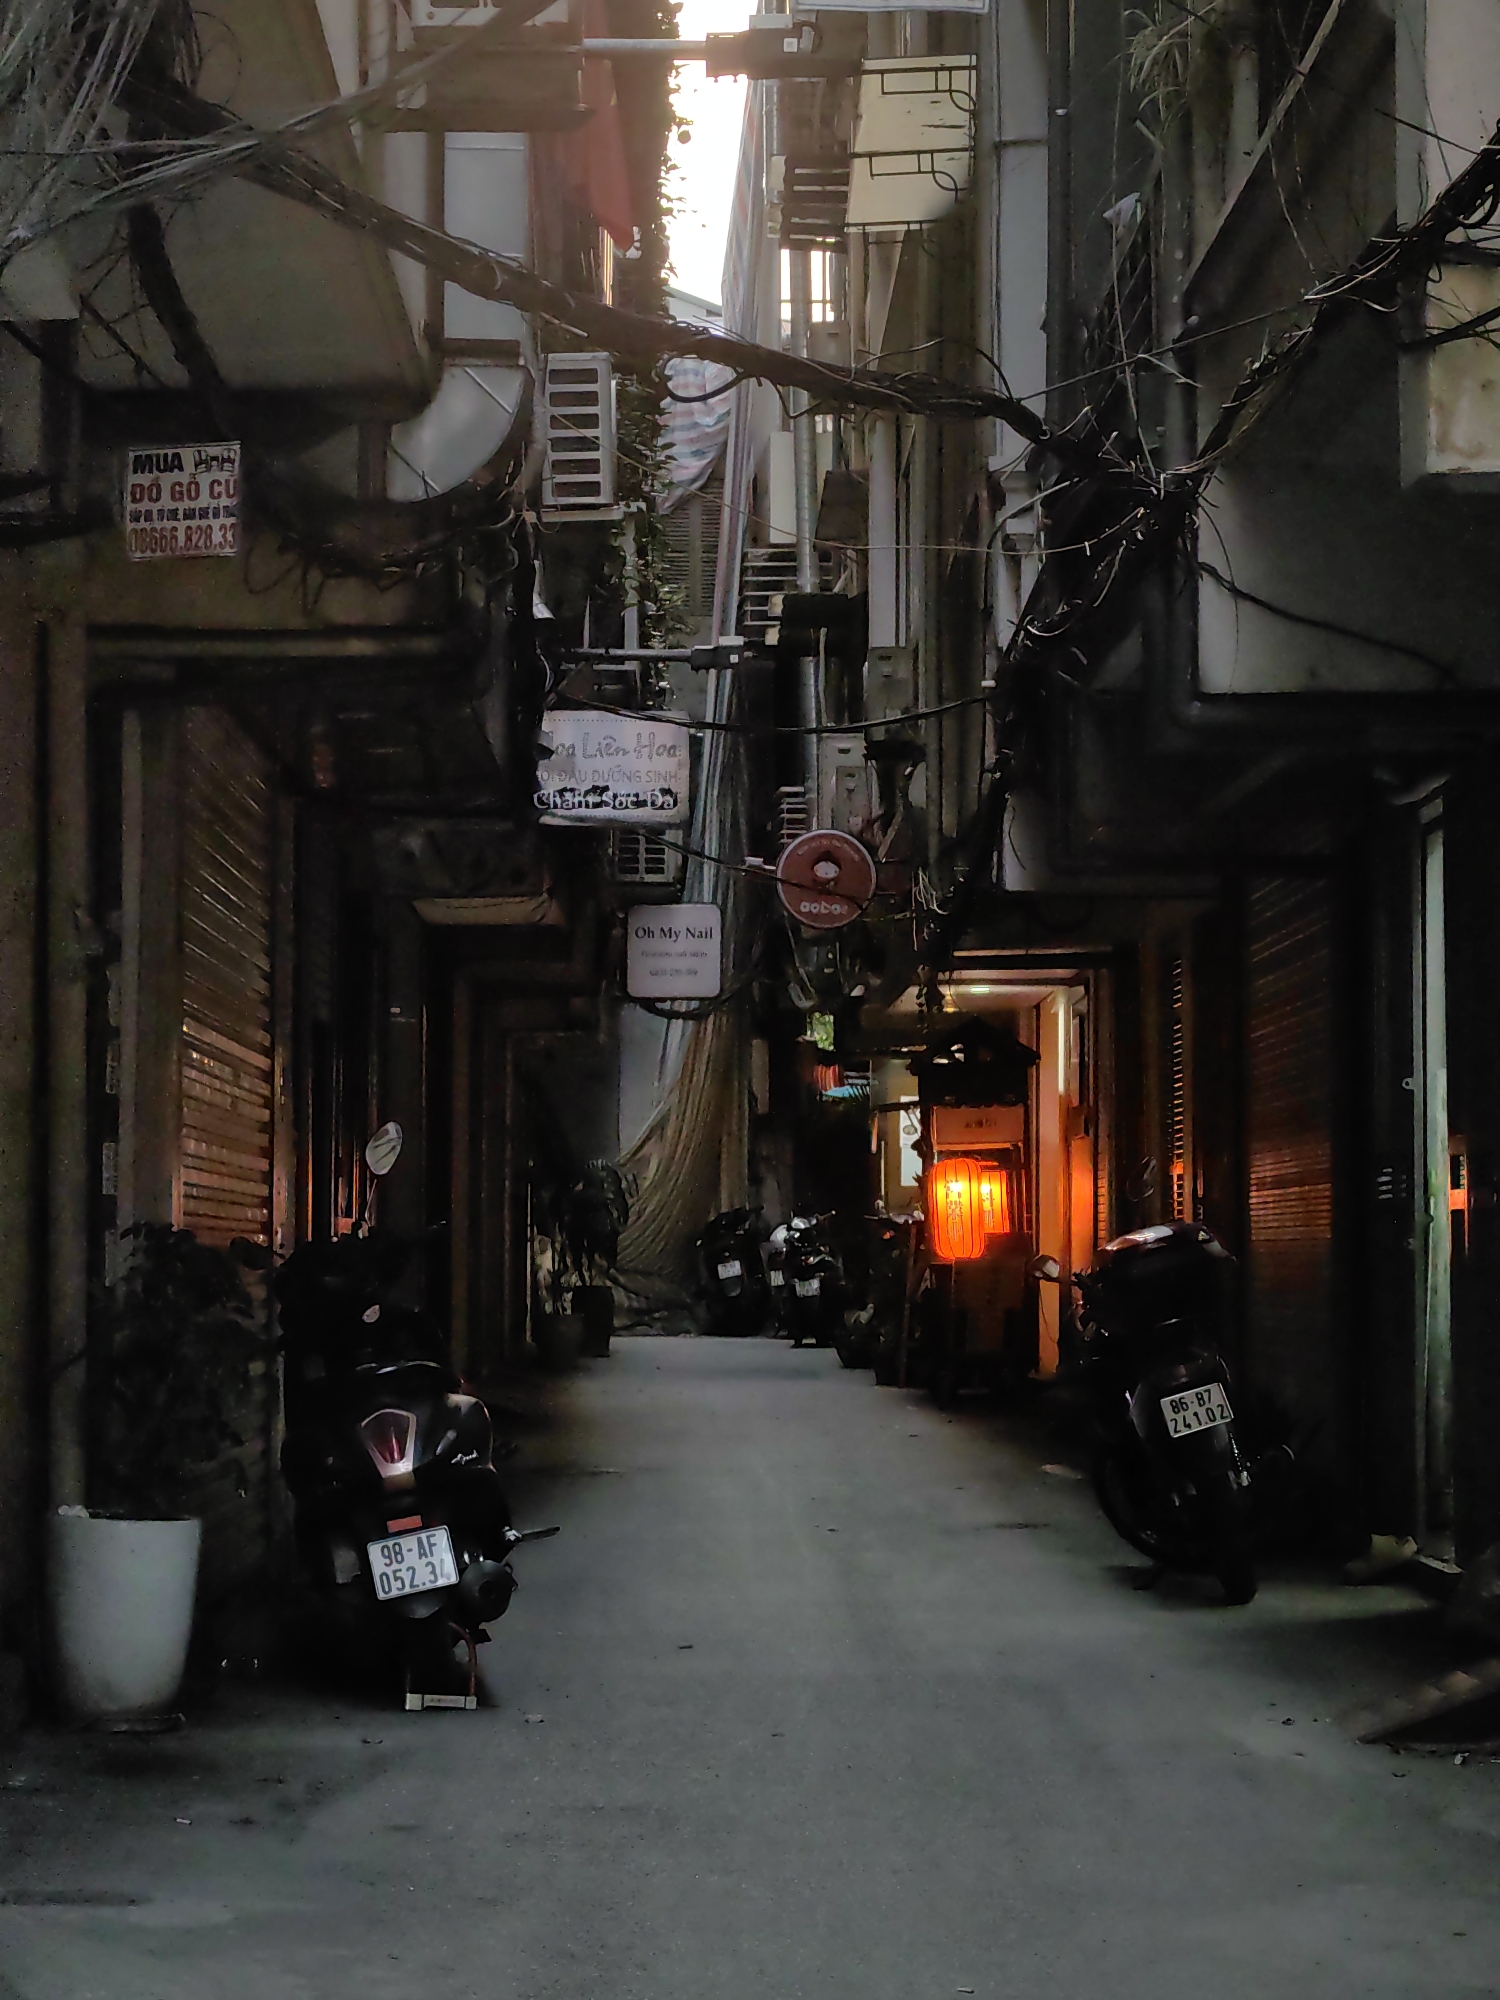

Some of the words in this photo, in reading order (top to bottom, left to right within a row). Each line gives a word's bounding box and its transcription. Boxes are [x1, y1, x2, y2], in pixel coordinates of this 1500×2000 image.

[132, 452, 184, 475] MUA
[582, 732, 630, 759] Liên
[634, 731, 678, 762] Hoa
[645, 770, 678, 783] SINH
[634, 926, 655, 939] Oh
[659, 927, 681, 943] My
[686, 926, 713, 939] Nail
[1170, 1404, 1229, 1434] 241.02
[380, 1533, 438, 1567] 98-AF
